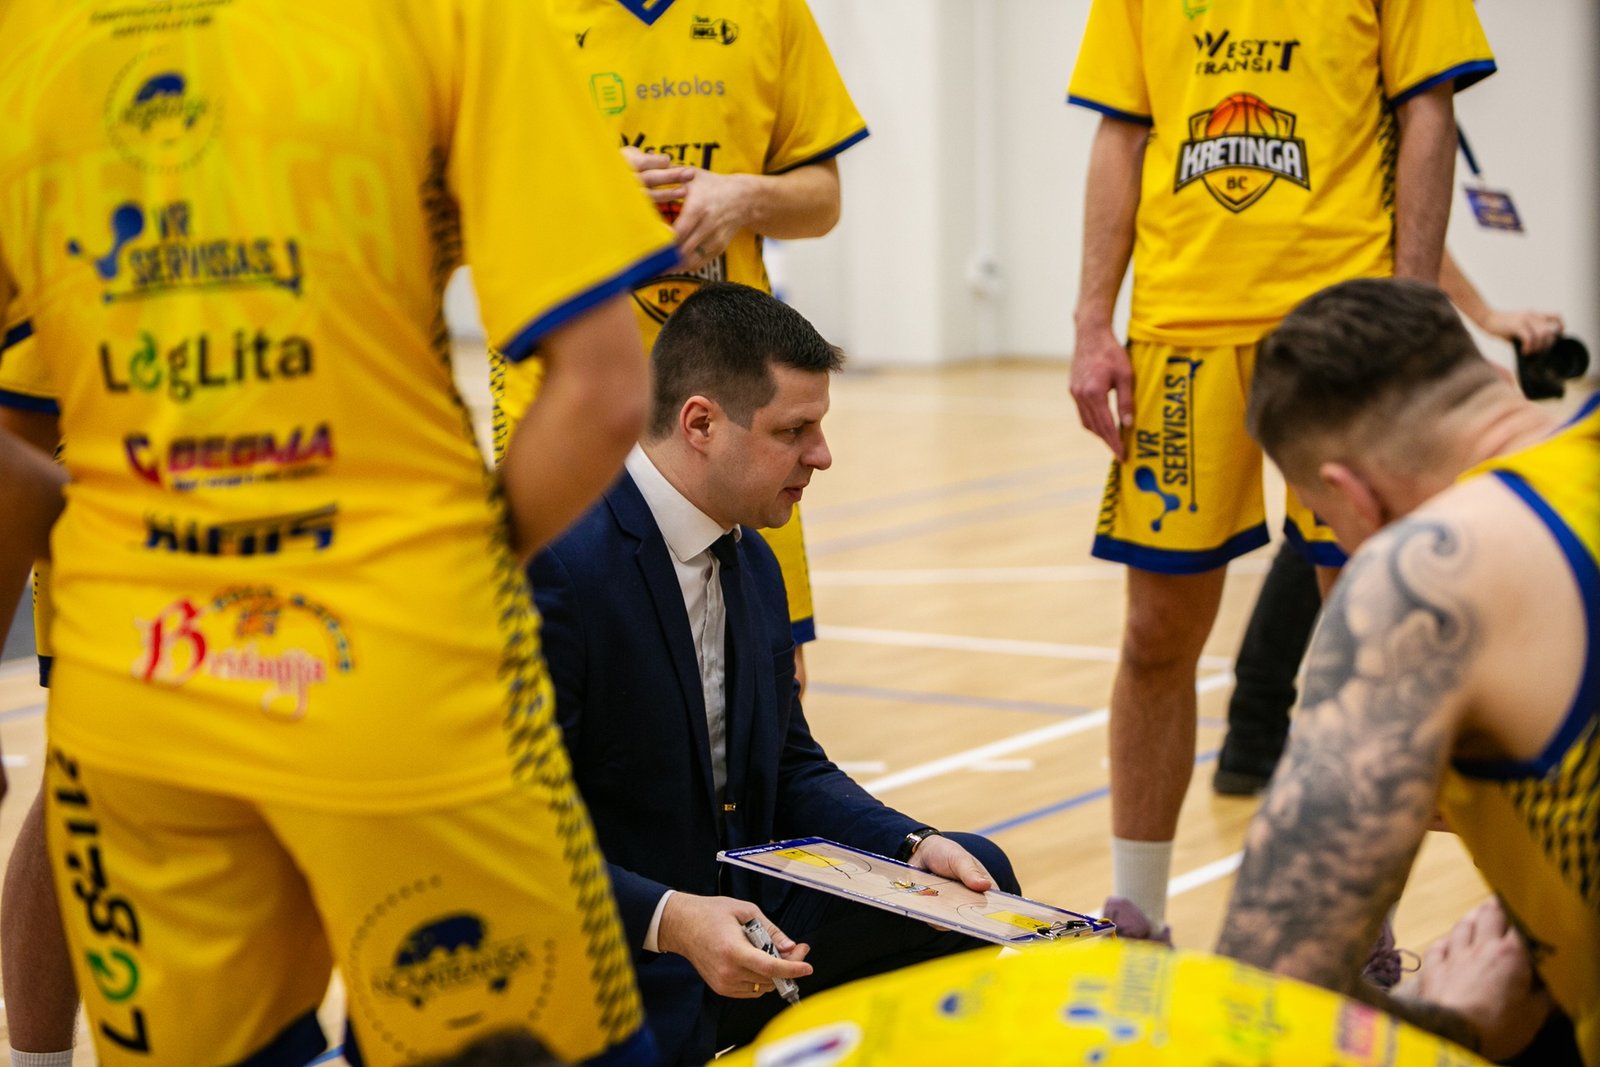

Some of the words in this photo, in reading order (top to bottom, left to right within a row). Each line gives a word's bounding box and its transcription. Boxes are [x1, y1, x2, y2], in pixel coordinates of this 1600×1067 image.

[636, 76, 726, 100] eskolos
[1226, 176, 1248, 190] BC
[658, 288, 681, 304] BC
[1163, 374, 1188, 486] SERVISAS
[1136, 429, 1160, 459] VR
